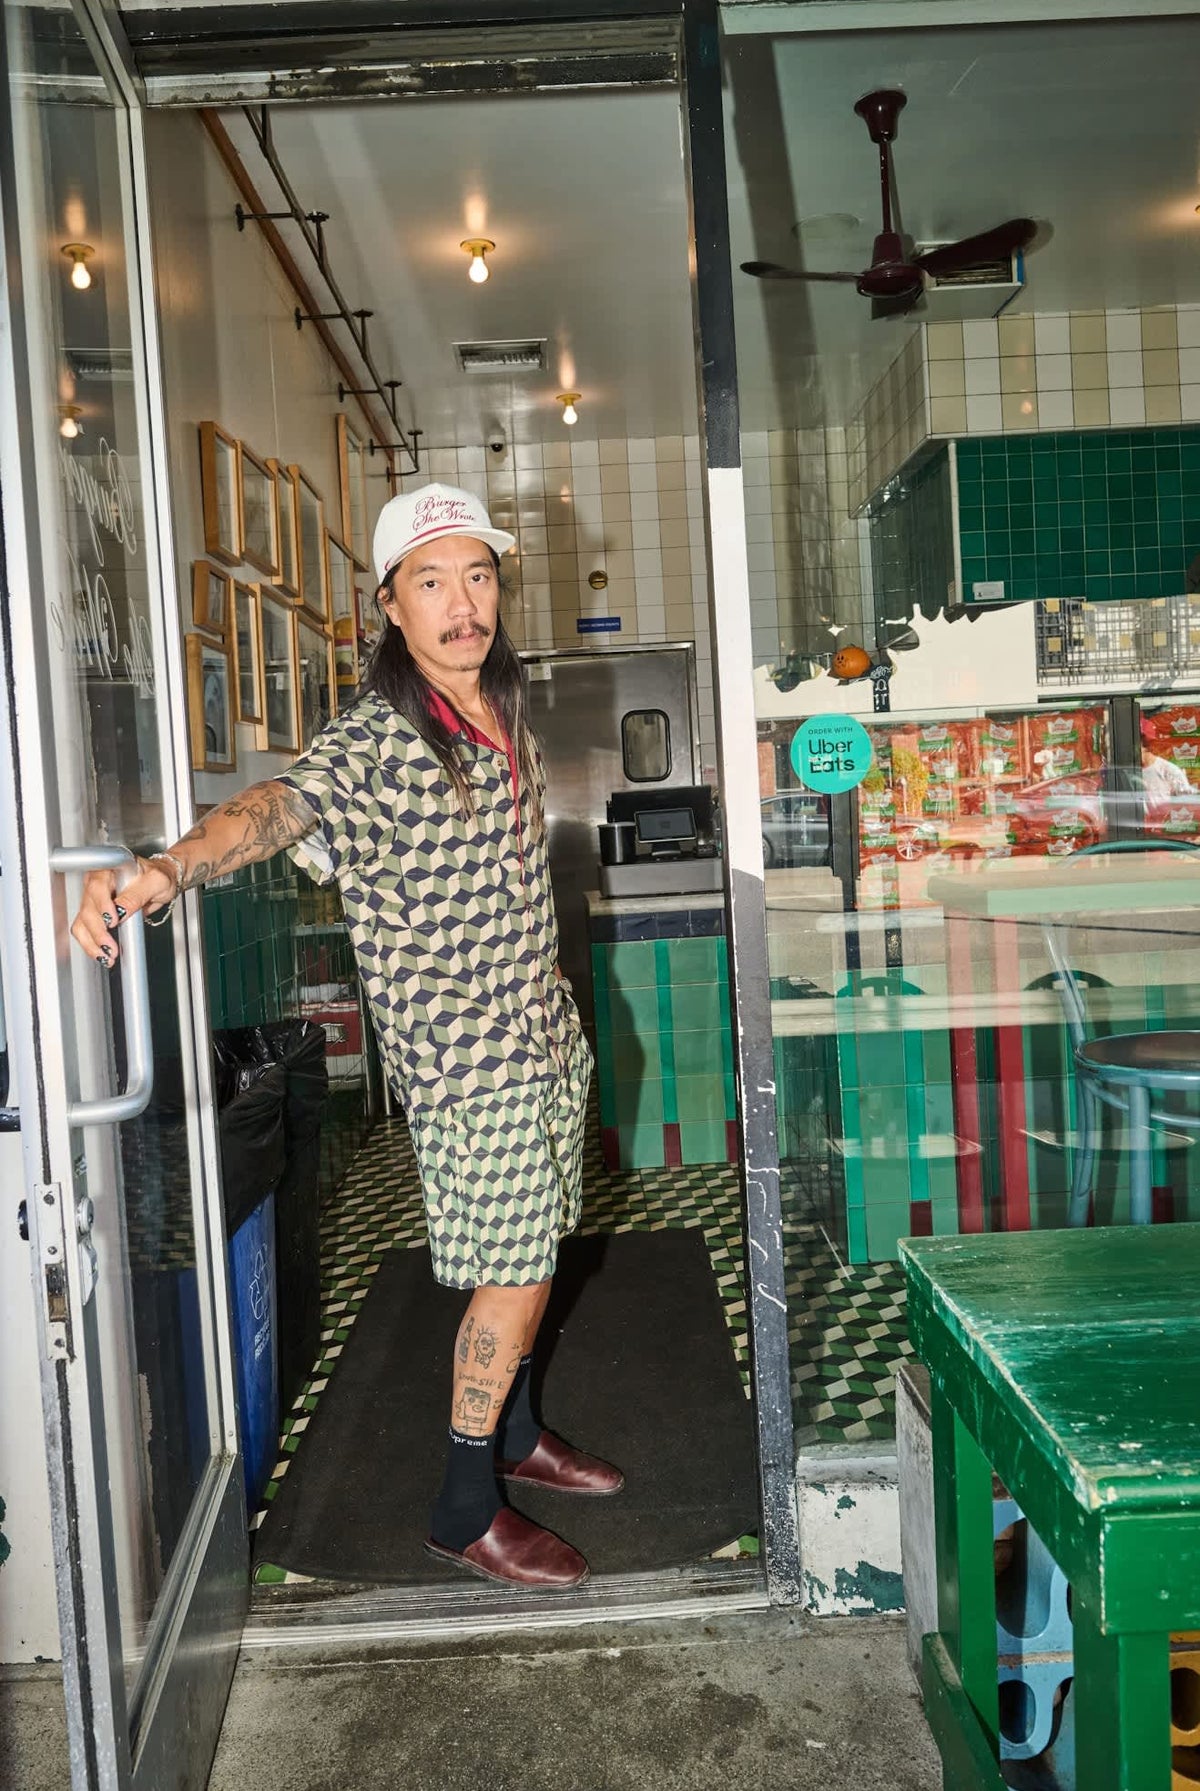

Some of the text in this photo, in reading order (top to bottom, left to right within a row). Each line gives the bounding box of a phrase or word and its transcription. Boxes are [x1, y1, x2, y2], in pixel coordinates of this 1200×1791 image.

[415, 496, 467, 514] Burger
[413, 511, 440, 531] She
[809, 739, 853, 755] Uber
[810, 757, 855, 773] Eats
